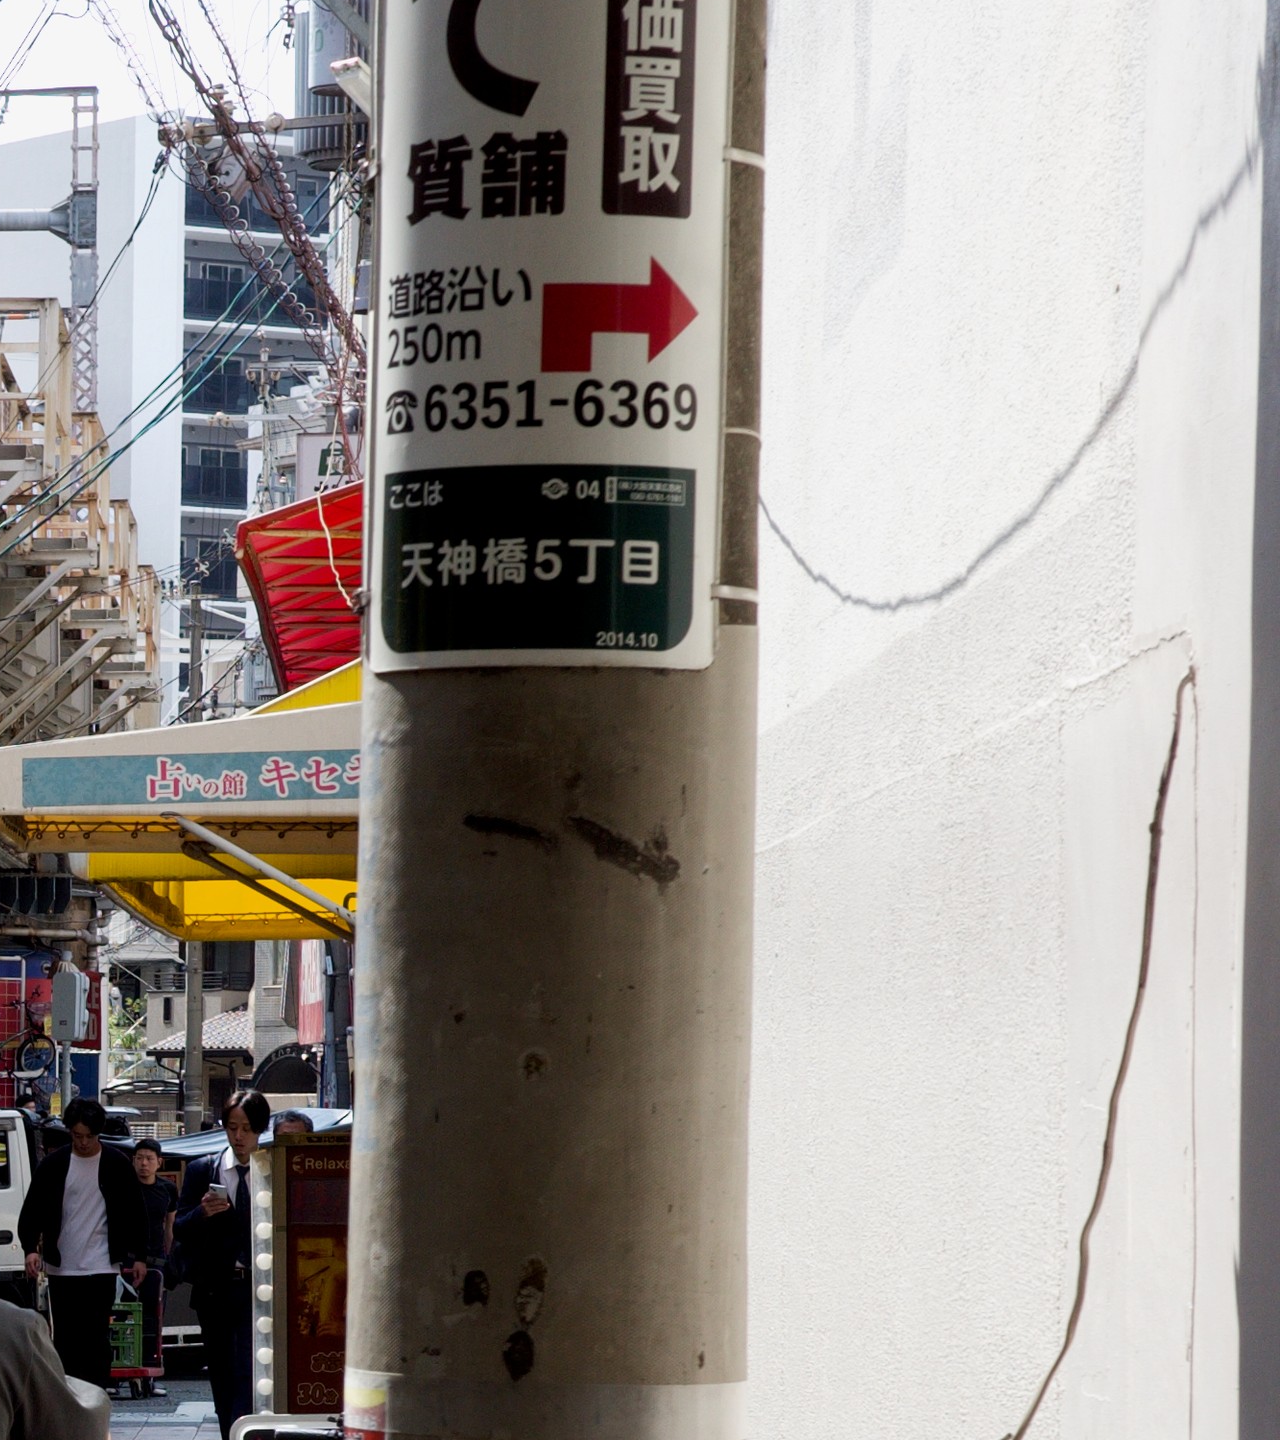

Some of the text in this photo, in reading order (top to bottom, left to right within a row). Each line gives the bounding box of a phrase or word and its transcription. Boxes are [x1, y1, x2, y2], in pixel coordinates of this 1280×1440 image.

[406, 129, 570, 227] 質舗
[386, 266, 534, 321] 道路沿い
[386, 322, 482, 370] 250m
[423, 378, 699, 434] 6351-6369
[389, 480, 444, 510] ここは
[576, 479, 600, 500] 04
[400, 537, 660, 589] 天神橋5丁目
[594, 630, 659, 649] 2014.10
[148, 758, 246, 799] 占いの館
